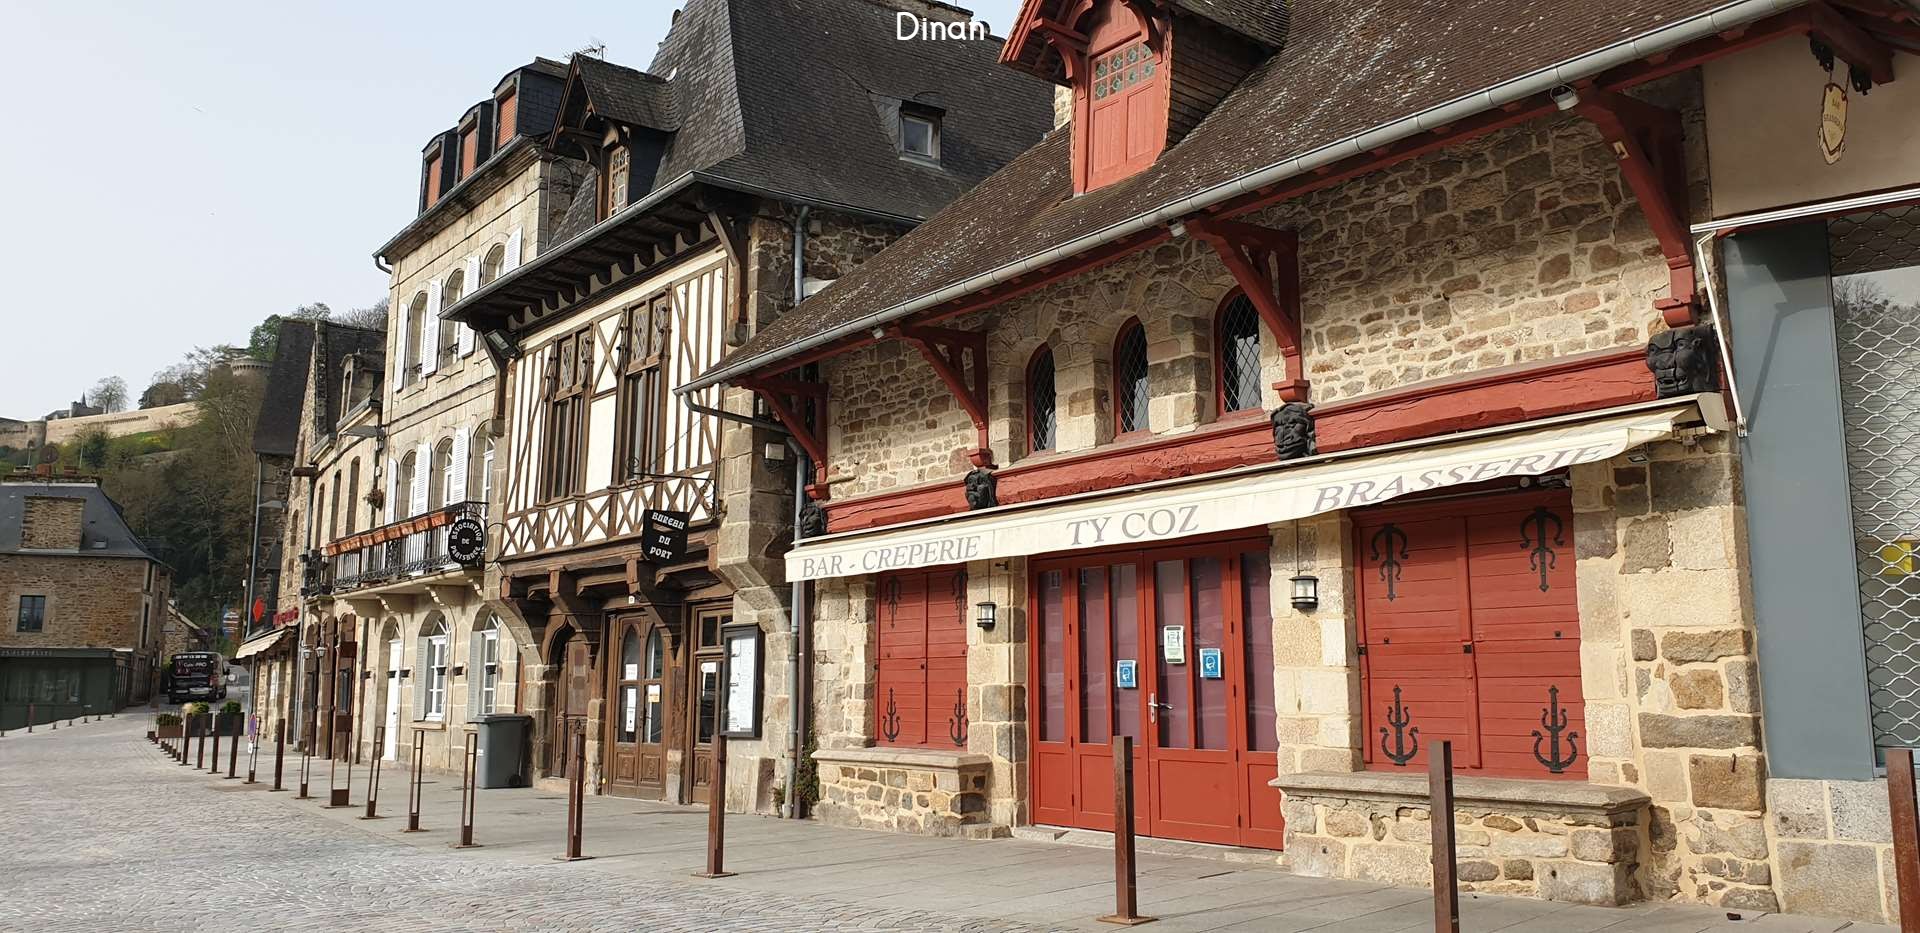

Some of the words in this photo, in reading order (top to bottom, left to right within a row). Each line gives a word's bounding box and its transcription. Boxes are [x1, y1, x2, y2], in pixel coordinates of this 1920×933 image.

[801, 552, 842, 578] BAR
[862, 535, 981, 571] CREPERIE
[1066, 516, 1111, 547] TY
[1121, 504, 1200, 539] COZ
[1311, 442, 1613, 513] BRASSERIE
[652, 512, 684, 529] BUREAU
[452, 522, 481, 541] ASSOCIATION
[659, 536, 671, 545] DU
[650, 547, 672, 559] PORT
